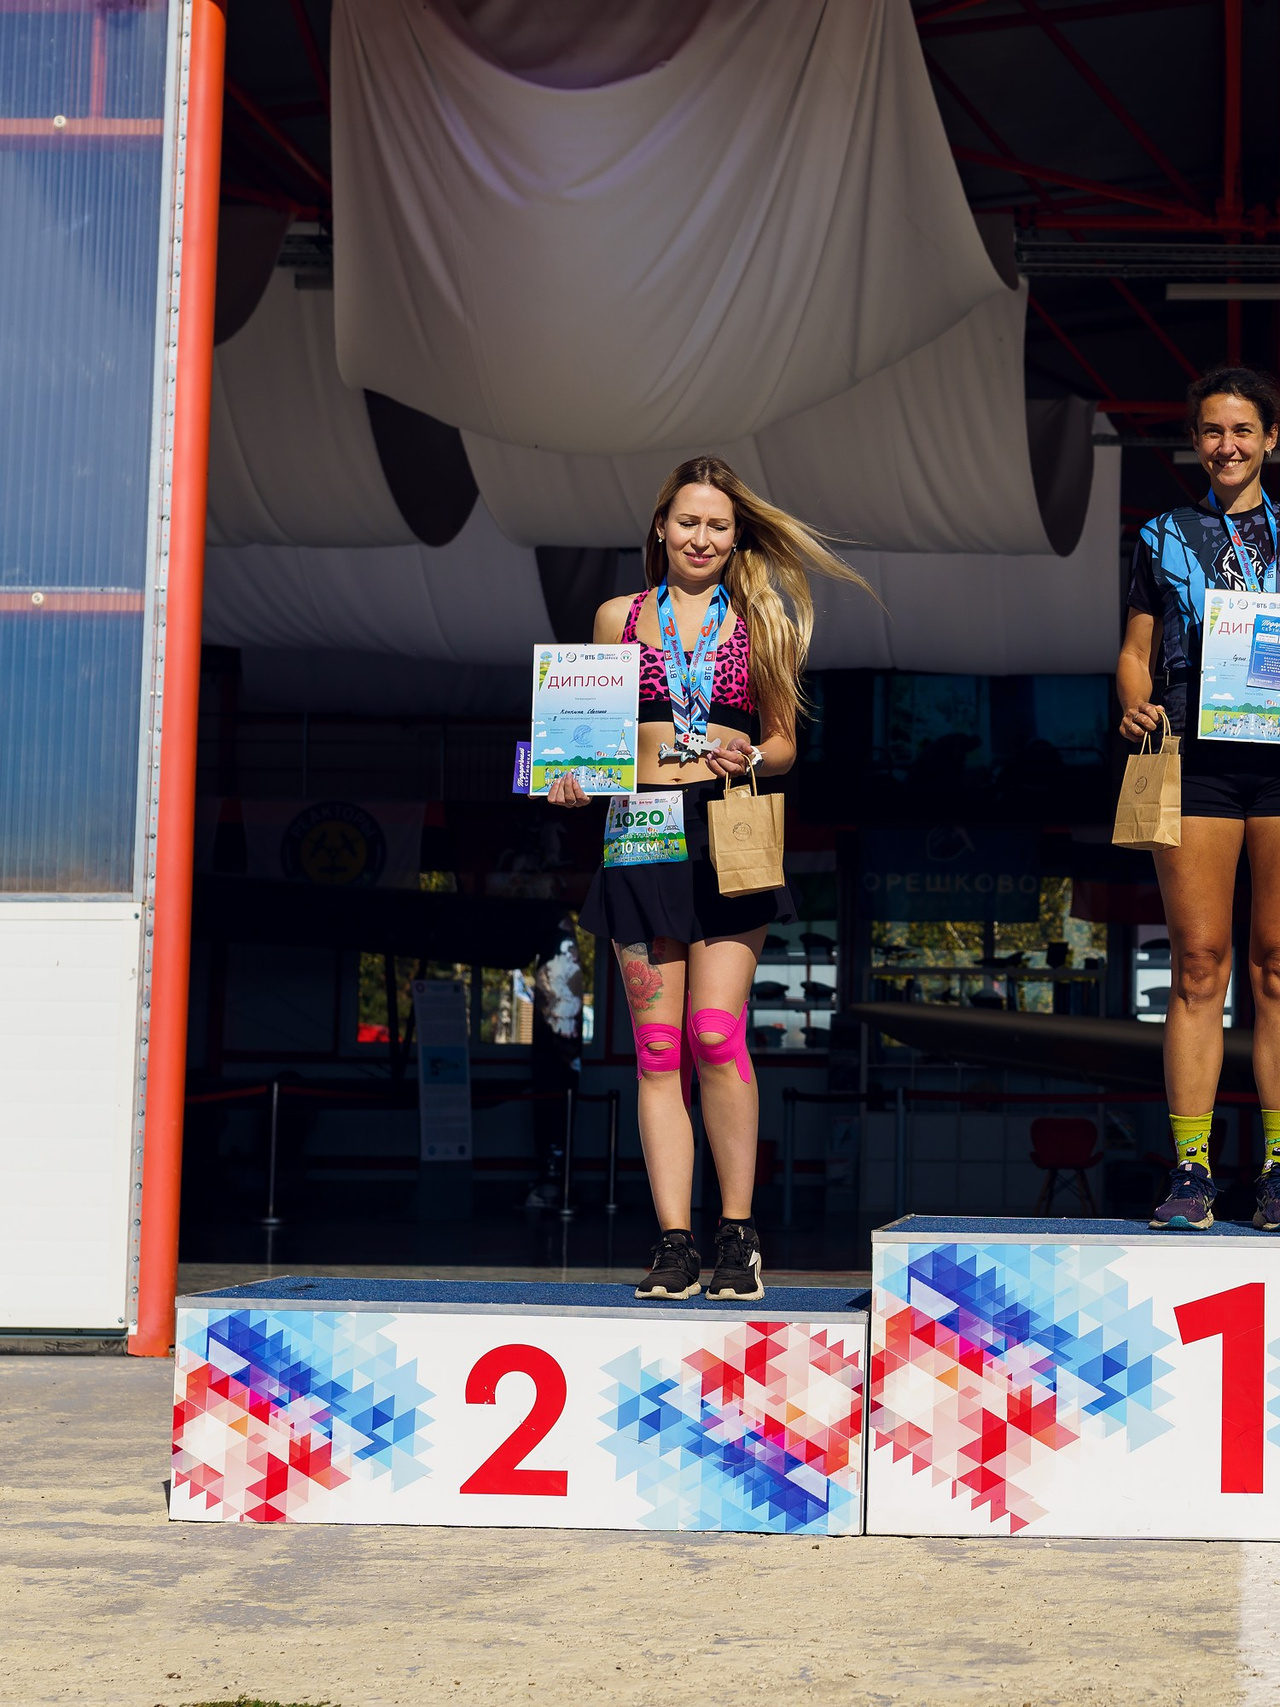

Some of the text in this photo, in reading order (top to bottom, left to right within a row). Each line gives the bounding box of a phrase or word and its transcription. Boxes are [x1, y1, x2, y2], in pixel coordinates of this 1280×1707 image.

[669, 664, 678, 679] ВТБ
[704, 666, 713, 681] ВТБ
[547, 676, 623, 690] ДИПЛОМ
[683, 734, 690, 743] 2
[615, 810, 665, 829] 1020
[621, 842, 658, 854] 10 КМ
[863, 872, 1038, 893] ОРЕШКОВО
[1173, 1282, 1265, 1494] 1
[459, 1343, 568, 1497] 2
